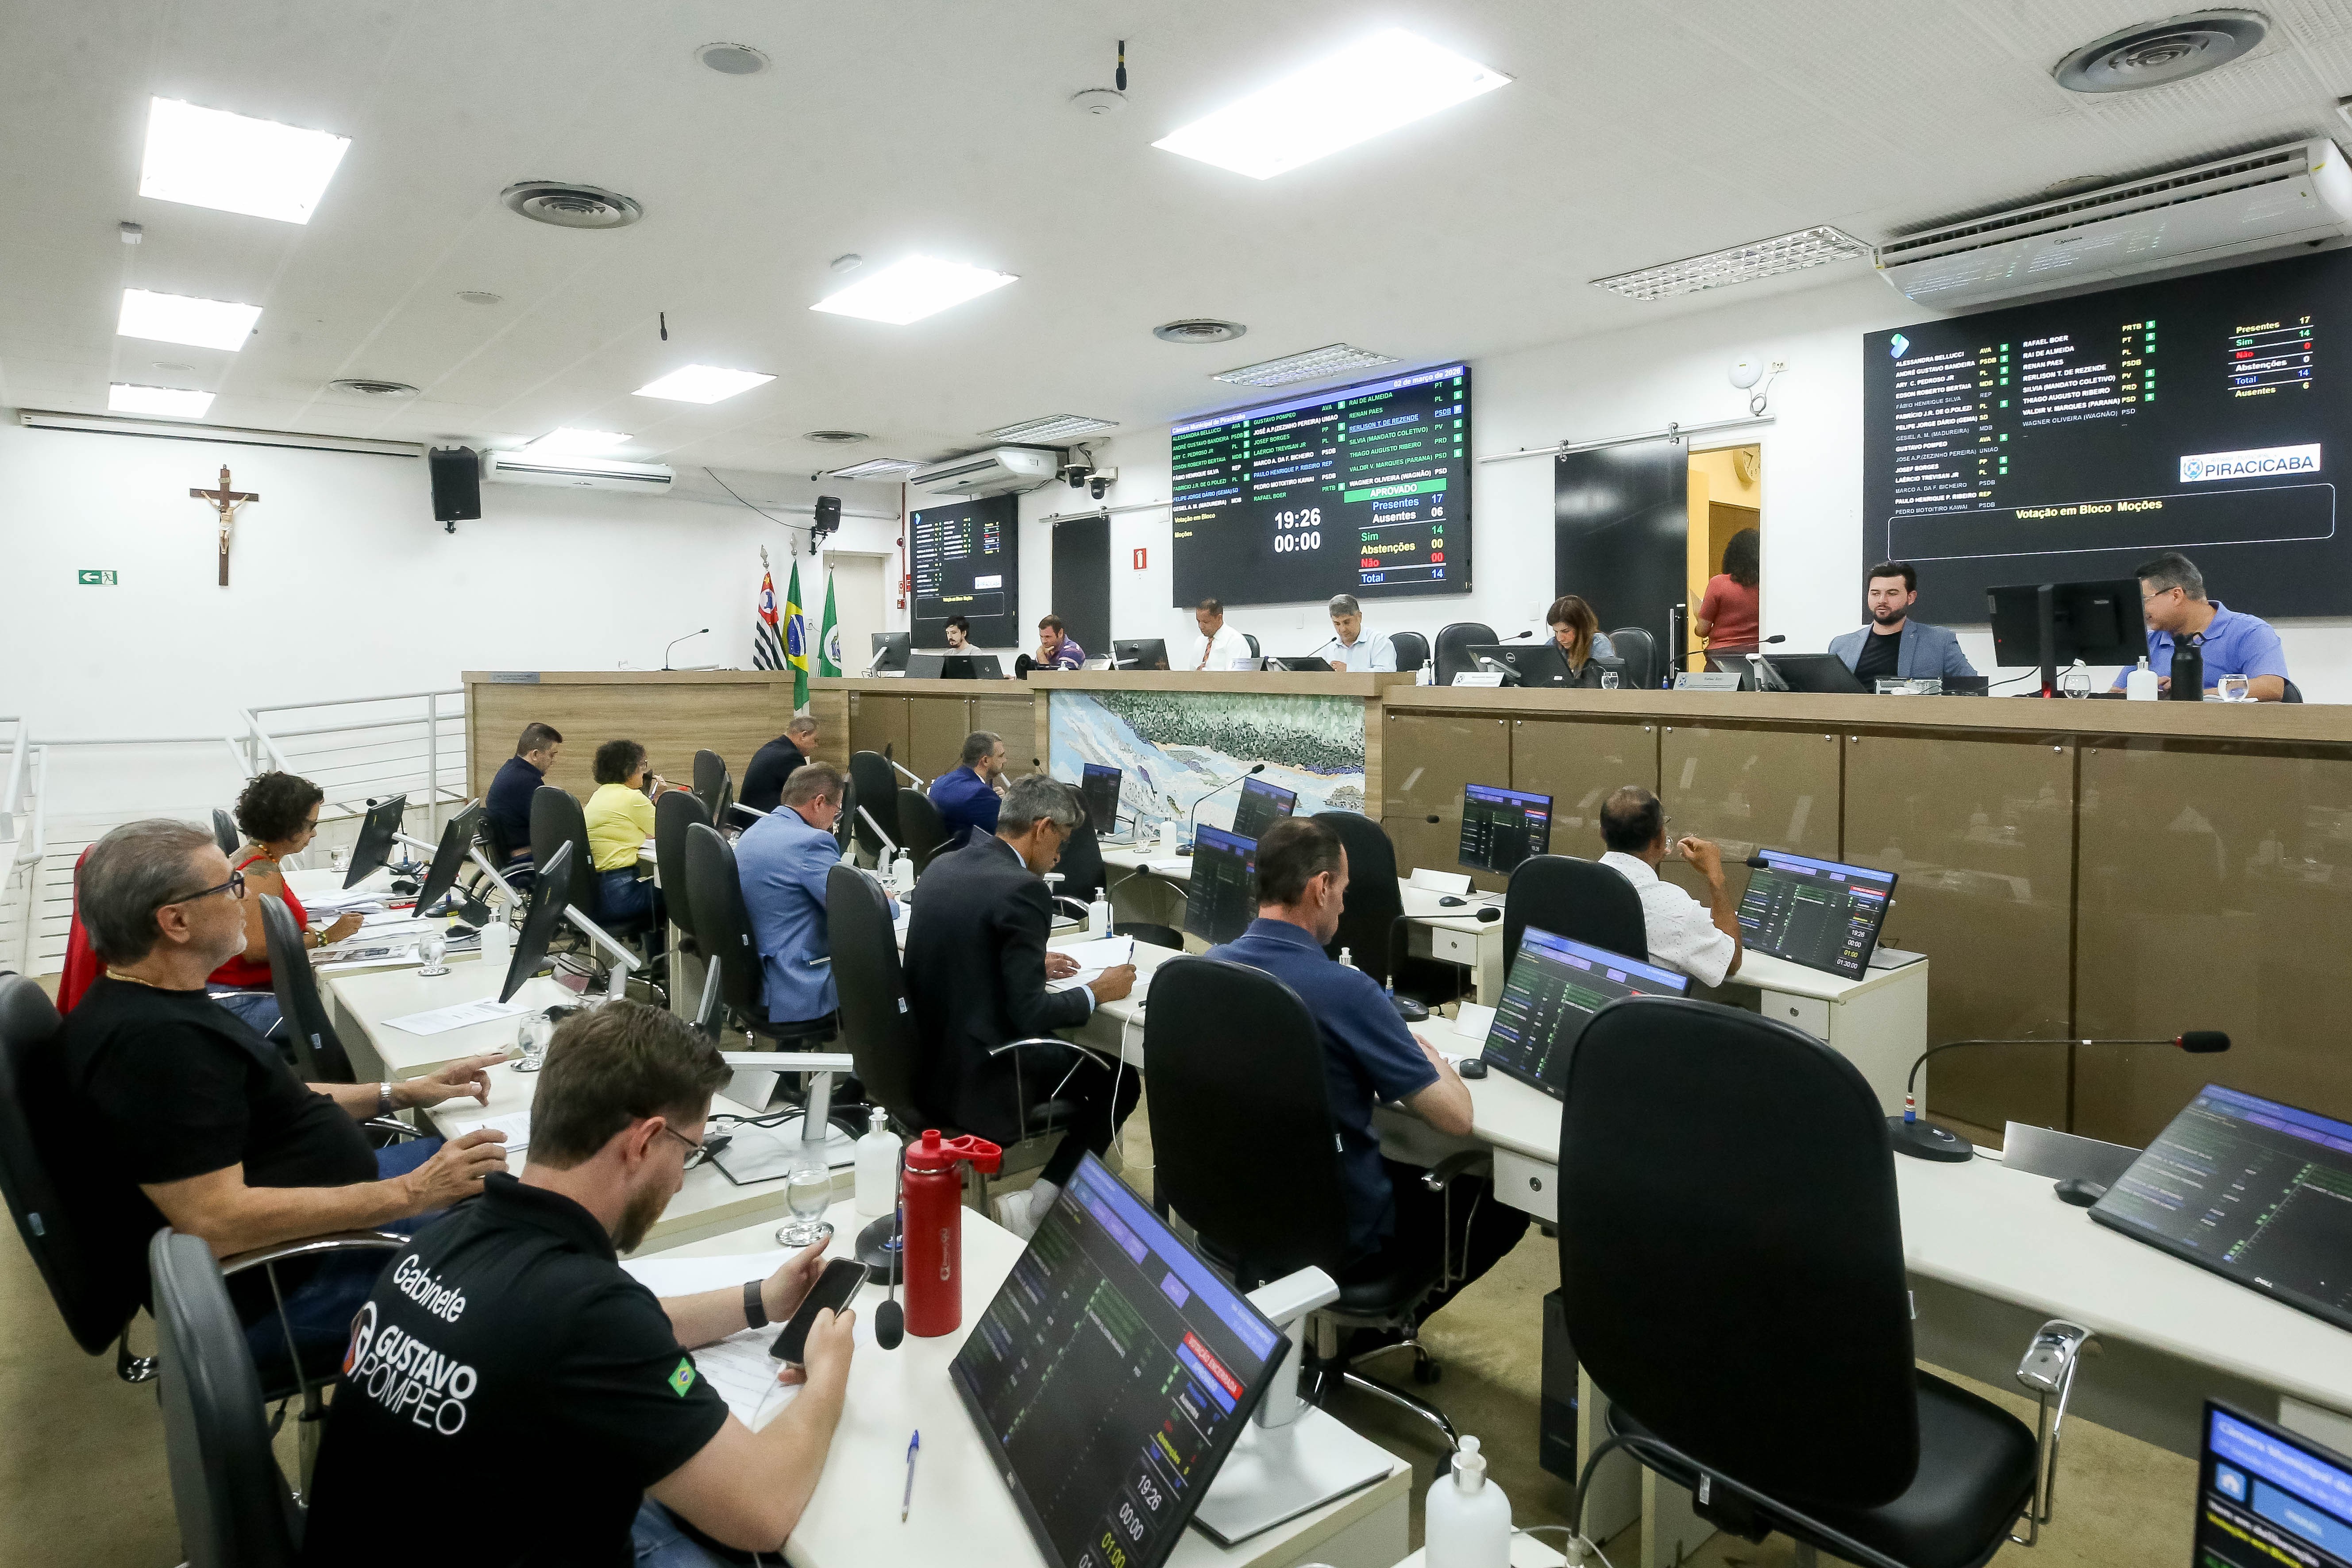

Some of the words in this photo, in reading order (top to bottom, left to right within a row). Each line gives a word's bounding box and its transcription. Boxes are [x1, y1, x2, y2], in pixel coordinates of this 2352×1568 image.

[2236, 322, 2279, 334] Presentes
[2046, 346, 2074, 355] ALMEIDA
[1896, 358, 1934, 367] ALESSANDRA
[1934, 351, 1964, 361] BELLUCCI
[2236, 360, 2287, 372] Abstenções
[1413, 374, 1434, 384] março
[1445, 367, 1461, 377] 2026
[1916, 366, 1943, 374] GUSTAVO
[1945, 361, 1975, 370] BANDEIRA
[2023, 372, 2055, 381] RERLISON
[2075, 364, 2107, 374] REZENDE
[2044, 381, 2078, 391] (MANDATO
[2079, 375, 2116, 385] COLETIVO)
[1368, 393, 1392, 402] ALMEIDA
[2048, 391, 2080, 401] AUGUSTO
[2082, 387, 2110, 397] RIBEIRO
[2236, 387, 2276, 397] Ausentes
[2054, 402, 2086, 412] MARQUES
[2088, 398, 2120, 408] (PARANA)
[1191, 420, 1212, 430] Municipal
[1220, 414, 1245, 424] Piracicaba
[1254, 416, 1275, 425] GUSTAVO
[1349, 421, 1376, 431] RERLISON
[1392, 414, 1419, 424] REZENDE
[1434, 408, 1451, 417] PSDB
[2052, 414, 2082, 423] OLIVEIRA
[2084, 411, 2117, 420] (WAGNÃO)
[1172, 432, 1199, 441] ALESSANDRA
[1367, 432, 1396, 443] (MANDATO
[1397, 427, 1428, 436] COLETIVO)
[1276, 443, 1299, 452] TREVISAN
[1371, 446, 1397, 455] AUGUSTO
[1376, 459, 1403, 468] MARQUES
[1405, 455, 1432, 465] (PARANA)
[2205, 456, 2313, 476] PIRACICABA
[1374, 475, 1400, 483] OLIVEIRA
[1401, 470, 1431, 481] (WAGNÃO)
[1370, 484, 1417, 497] APROVADO
[1373, 498, 1419, 511] Presentes
[1432, 493, 1443, 503] 17
[2016, 508, 2058, 519] Votação
[2060, 507, 2077, 516] em
[2079, 504, 2112, 514] Bloco
[2117, 501, 2163, 512] Moções
[1275, 508, 1321, 530] 19:26
[1373, 511, 1416, 524] Ausentes
[1431, 507, 1443, 517] 06
[1361, 532, 1379, 541] Sim
[1432, 525, 1443, 534] 14
[1275, 531, 1321, 553] 00:00
[1361, 543, 1415, 555] Abstenções
[1431, 538, 1443, 548] 00
[1361, 559, 1379, 567] Não
[1431, 552, 1443, 562] 00
[1361, 573, 1384, 583] Total
[1432, 569, 1443, 578] 14
[1837, 959, 1858, 969] 01:30:00
[393, 1254, 466, 1322] Gabinete
[375, 1325, 477, 1399] GUSTAVO
[353, 1352, 466, 1435] POMPEO
[1138, 1475, 1161, 1511] 19:26
[1119, 1503, 1143, 1541] 00:00
